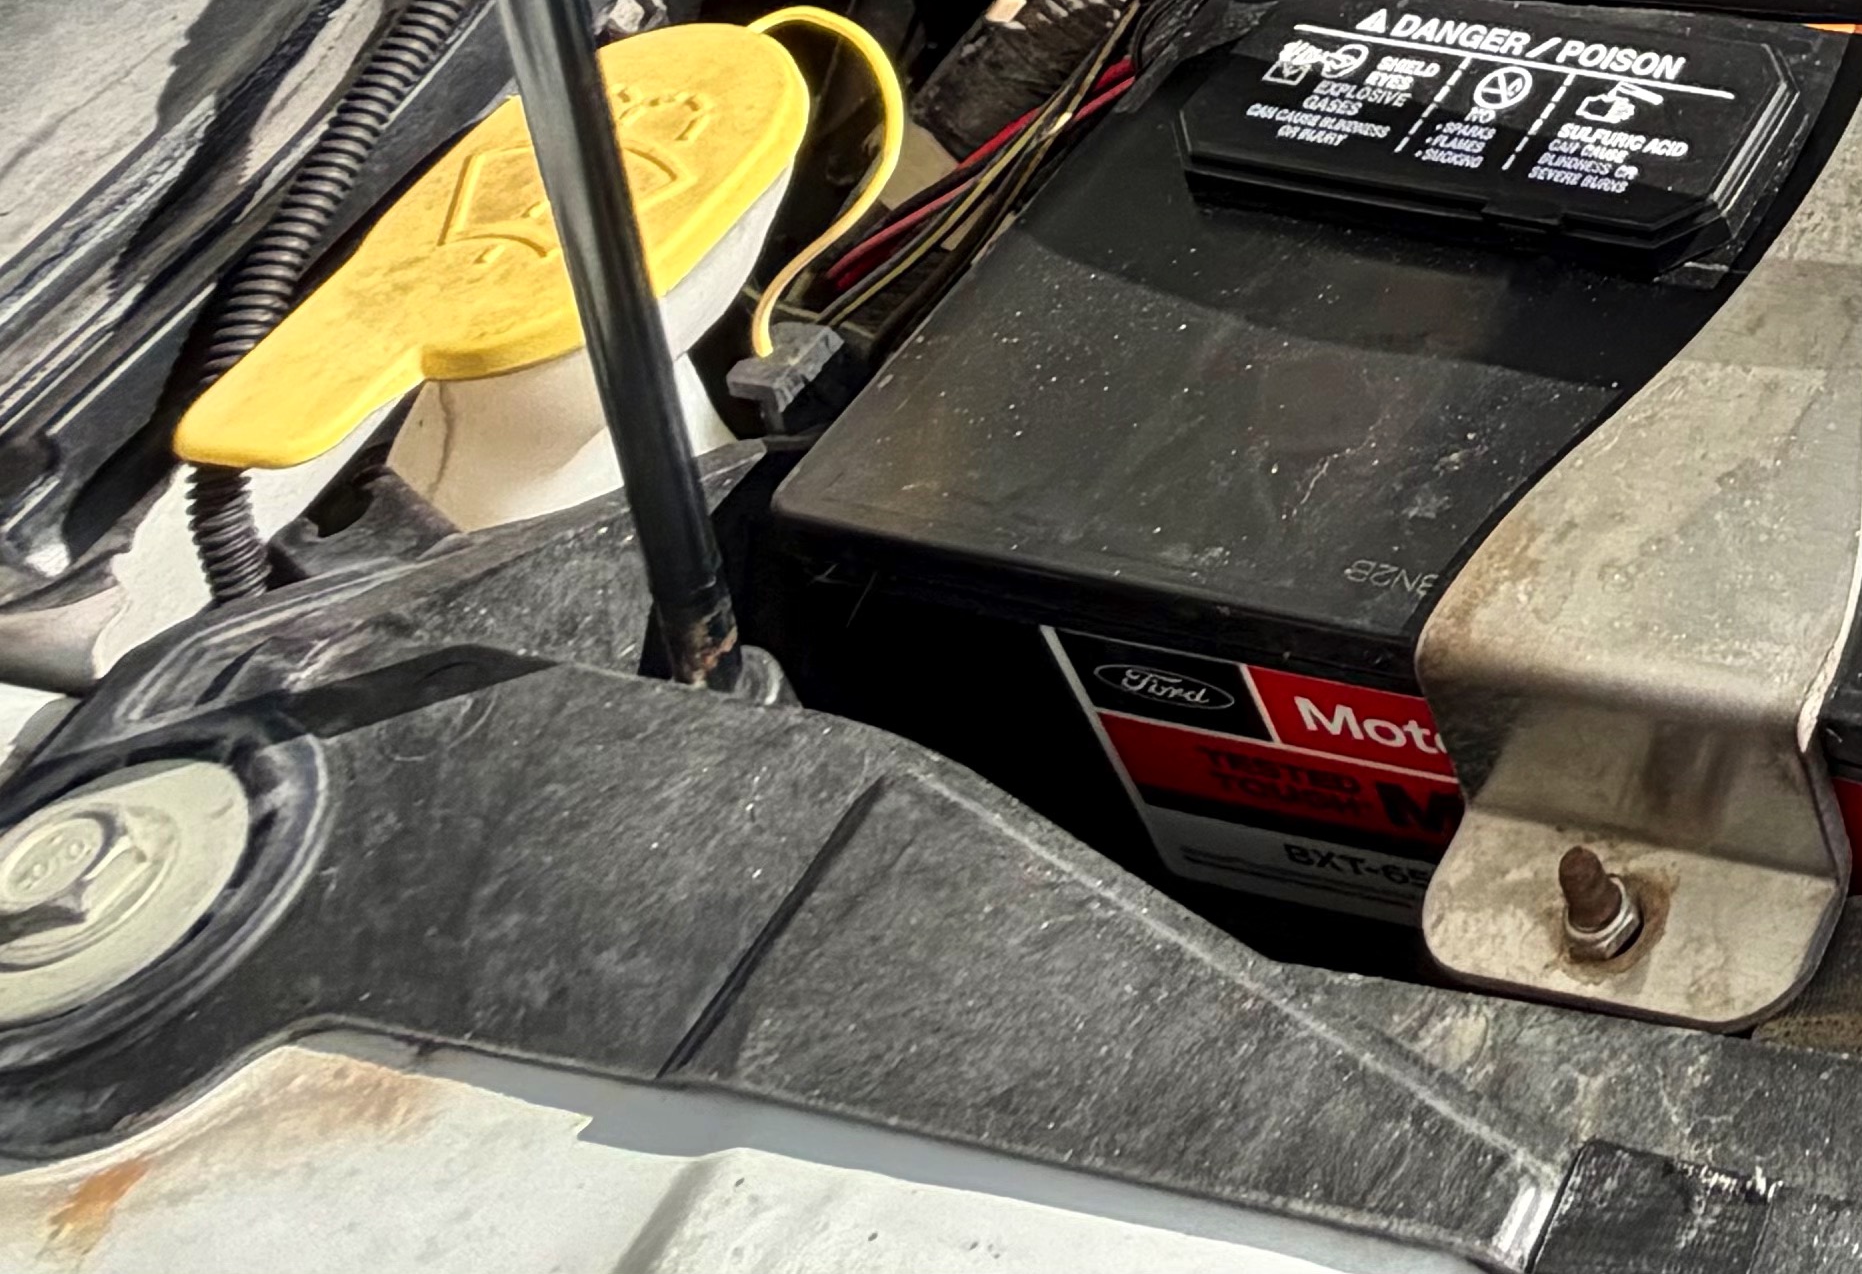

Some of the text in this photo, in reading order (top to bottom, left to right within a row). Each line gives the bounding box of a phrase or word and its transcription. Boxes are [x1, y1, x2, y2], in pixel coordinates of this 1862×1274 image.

[1390, 13, 1530, 57] DANGER
[1555, 40, 1686, 81] POISON
[1377, 56, 1440, 77] SHIELD
[1364, 71, 1414, 90] EYES
[1313, 80, 1412, 107] EXPLOSIVE
[1246, 103, 1276, 119] CAN
[1302, 94, 1362, 116] GASES
[1465, 106, 1496, 123] NO
[1549, 139, 1579, 154] CAN
[1557, 123, 1689, 157] SULFURIC ACID
[1537, 152, 1613, 175] BLINDNESS
[1528, 166, 1582, 187] SEVERE
[1118, 665, 1212, 706] Ford
[1198, 747, 1360, 794] TESTED
